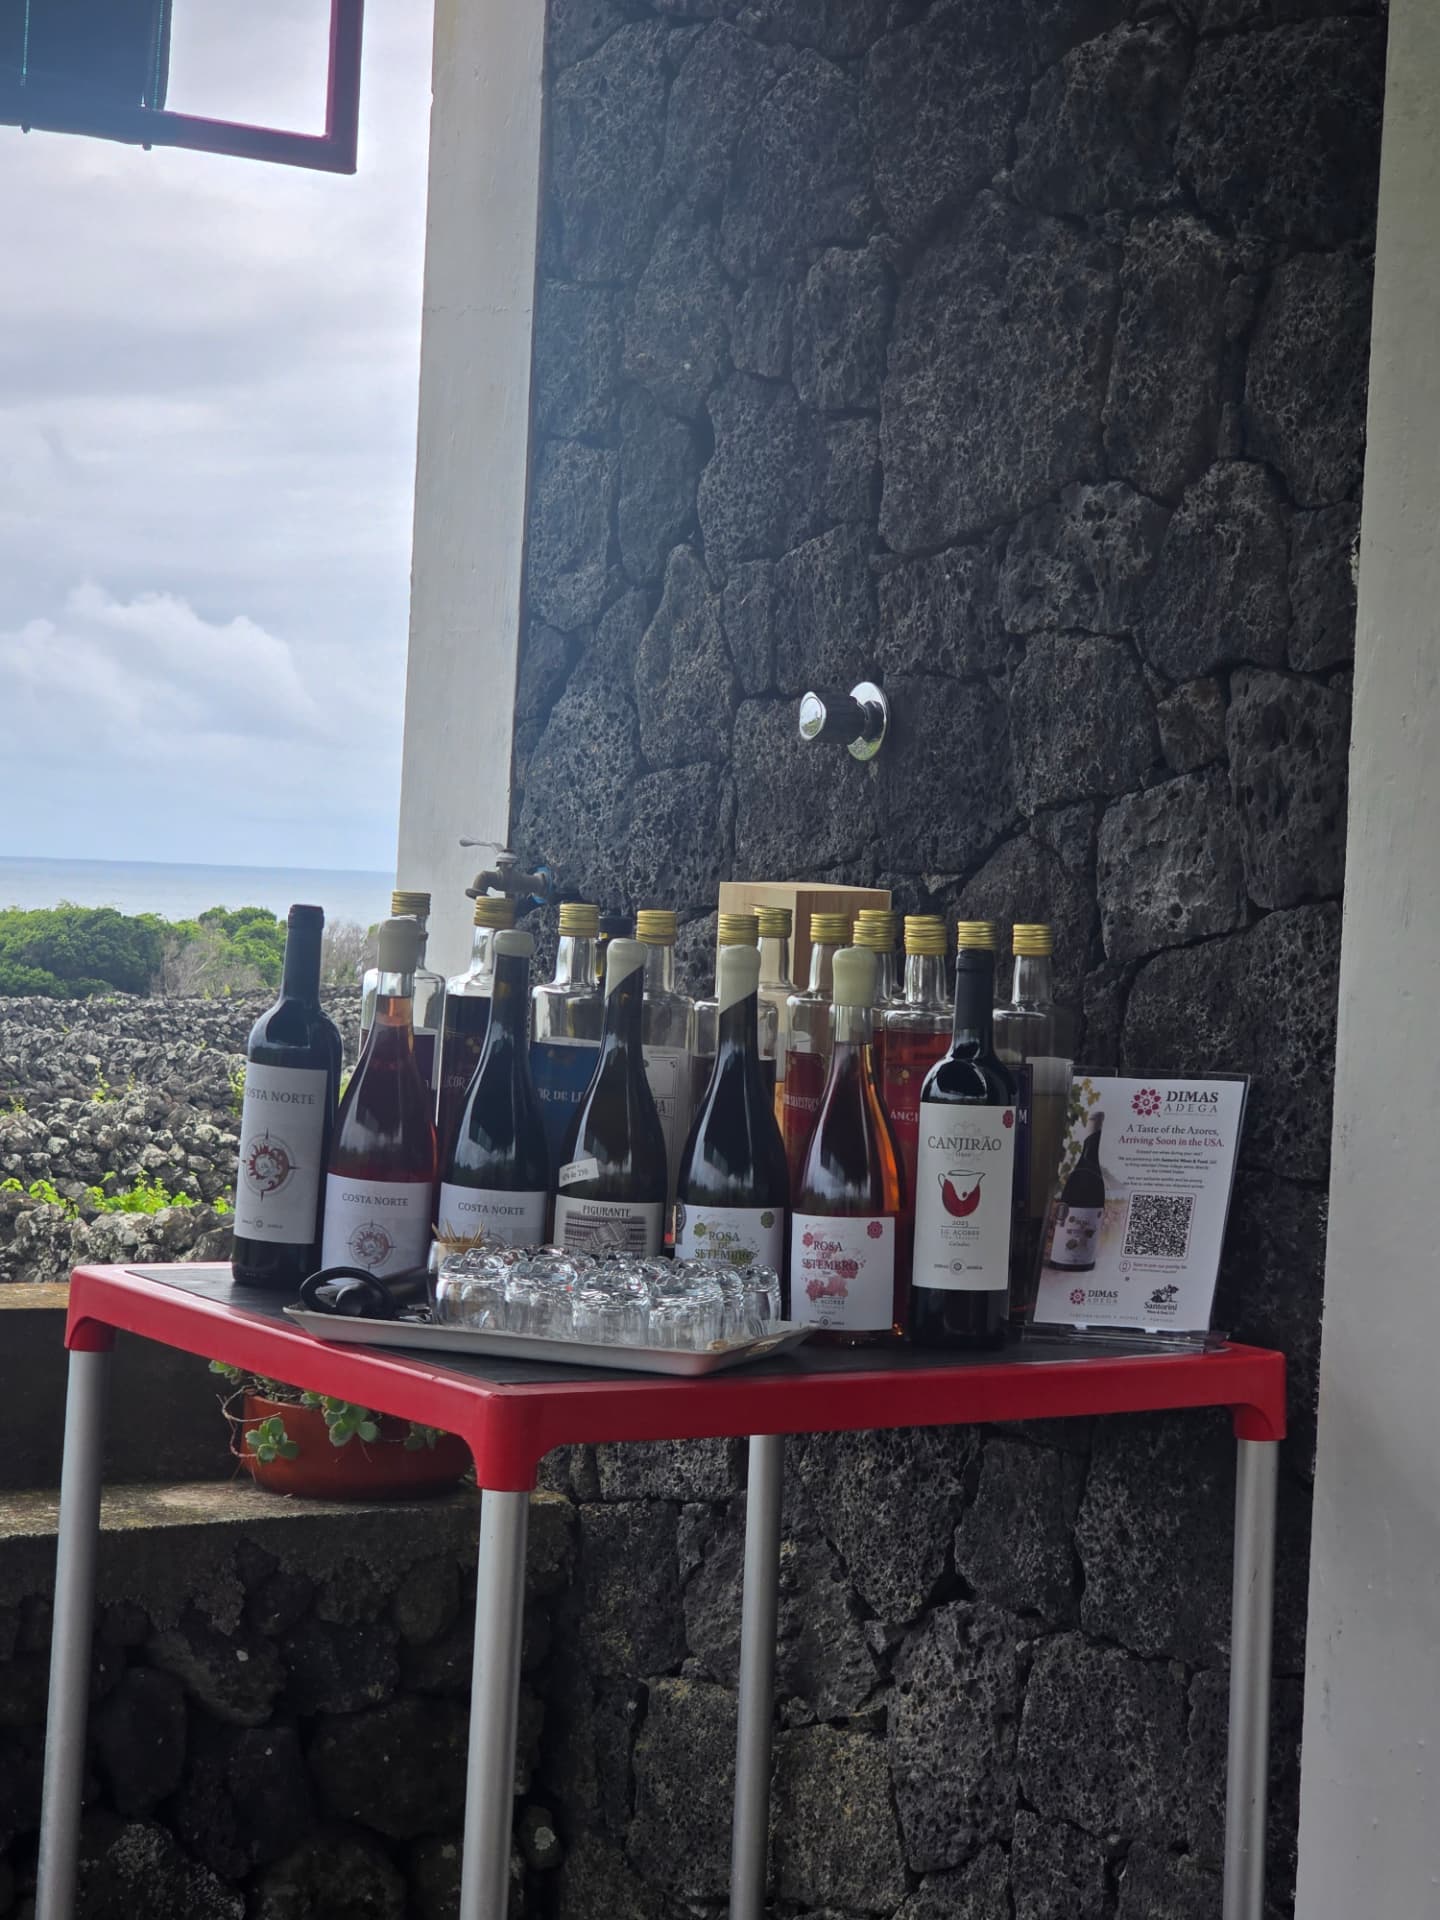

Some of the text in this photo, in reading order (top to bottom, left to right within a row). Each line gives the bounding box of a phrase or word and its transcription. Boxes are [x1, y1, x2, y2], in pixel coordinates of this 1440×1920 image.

[271, 1091, 316, 1105] NORTE
[1166, 1091, 1219, 1103] DIMAS
[1164, 1103, 1218, 1113] ADEGA
[1126, 1124, 1219, 1136] A Taste of the Azores,
[928, 1136, 1002, 1152] CANJIRÃO
[1118, 1135, 1225, 1148] Arriving Soon in the USA.
[342, 1193, 409, 1207] COSTA NORTE
[458, 1202, 525, 1216] COSTA NORTE
[582, 1205, 632, 1218] FIGURANTE
[708, 1231, 740, 1242] ROSA
[813, 1241, 843, 1252] ROSA
[802, 1258, 859, 1271] SETEMBRO
[1087, 1289, 1119, 1298] DIMAS
[1144, 1301, 1178, 1312] Santorini
